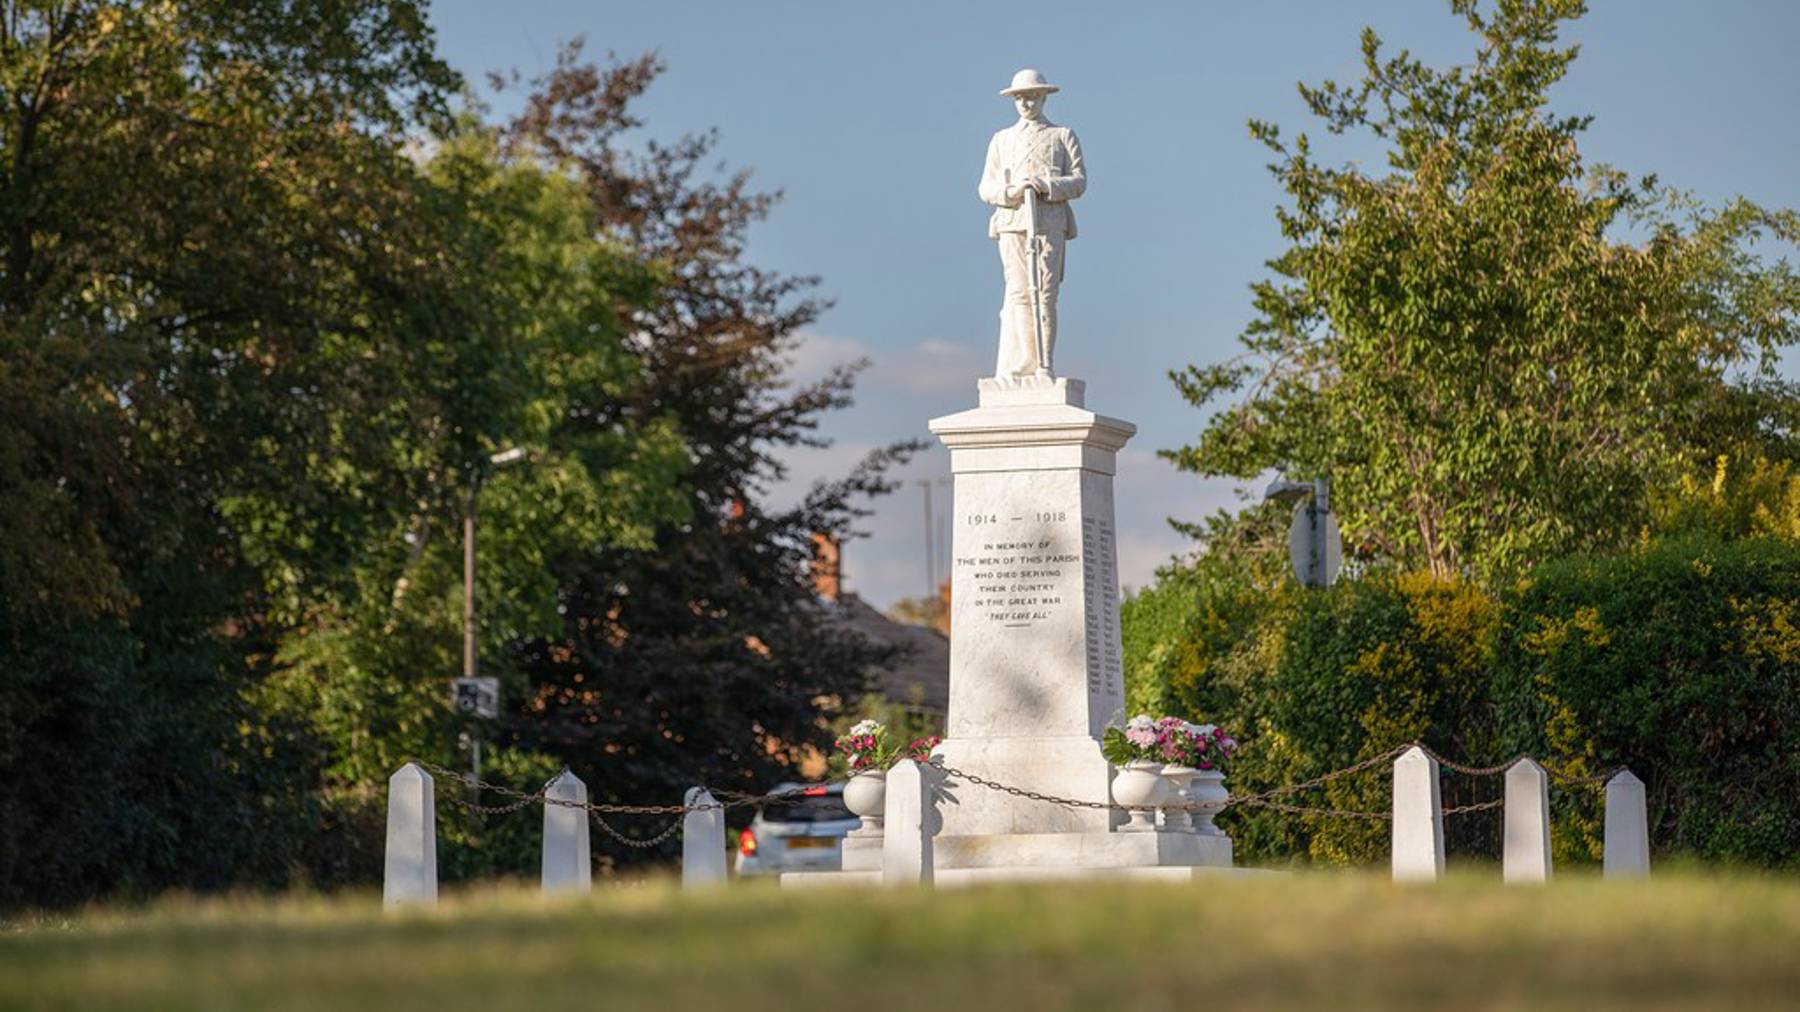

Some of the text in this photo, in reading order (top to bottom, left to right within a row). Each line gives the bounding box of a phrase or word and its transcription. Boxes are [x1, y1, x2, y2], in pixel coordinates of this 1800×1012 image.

[967, 514, 997, 525] 1914
[1036, 512, 1066, 523] 1918
[996, 542, 1034, 550] MEMORY
[1038, 541, 1051, 549] OF
[957, 554, 1080, 566] THE MEN OF THIS PARISH
[974, 569, 1062, 579] WHO DIED SERVING
[979, 583, 1055, 593] THEIR COUNTRY
[975, 599, 984, 607] IN
[987, 598, 1004, 606] THE
[1008, 597, 1038, 606] GREAT
